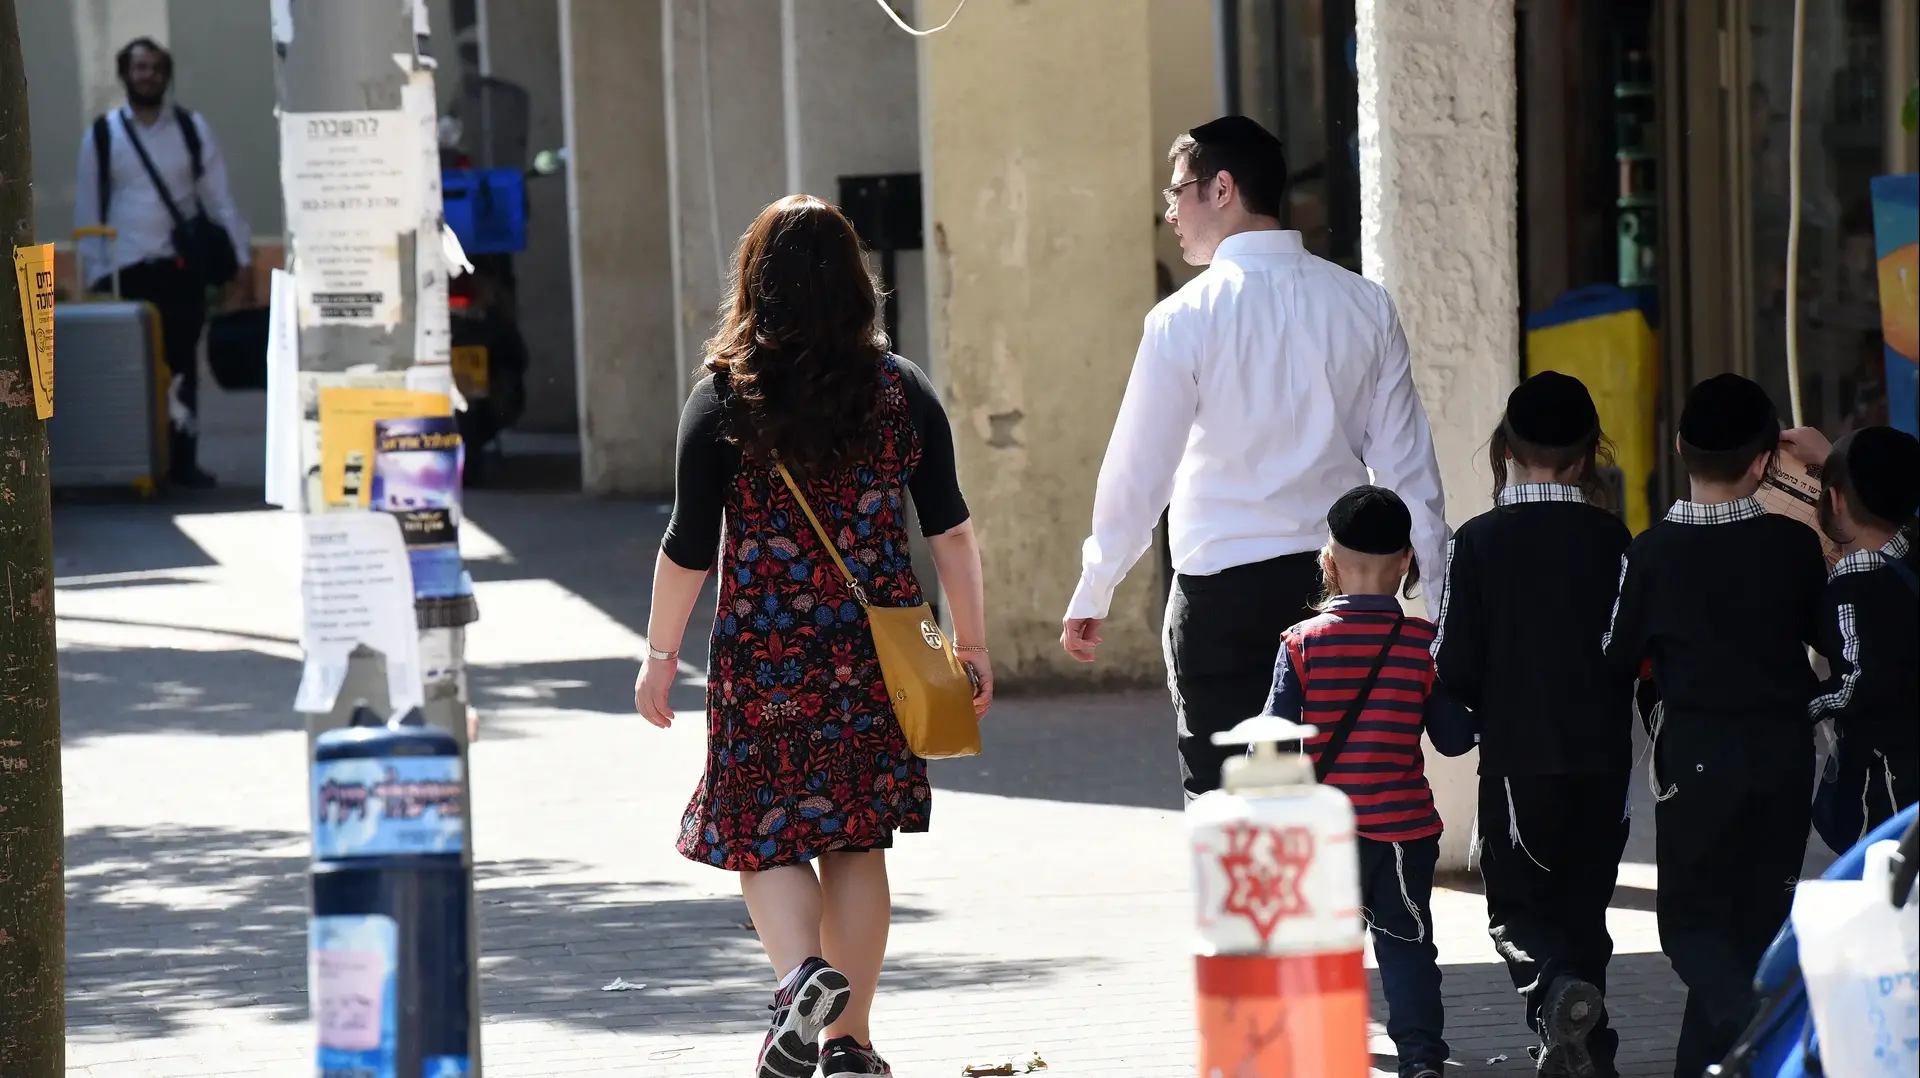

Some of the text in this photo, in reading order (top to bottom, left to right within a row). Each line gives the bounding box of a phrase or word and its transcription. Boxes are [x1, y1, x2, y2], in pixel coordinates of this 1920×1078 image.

[307, 116, 379, 138] להשכרה
[36, 271, 52, 289] בדים
[1808, 485, 1822, 496] רשו
